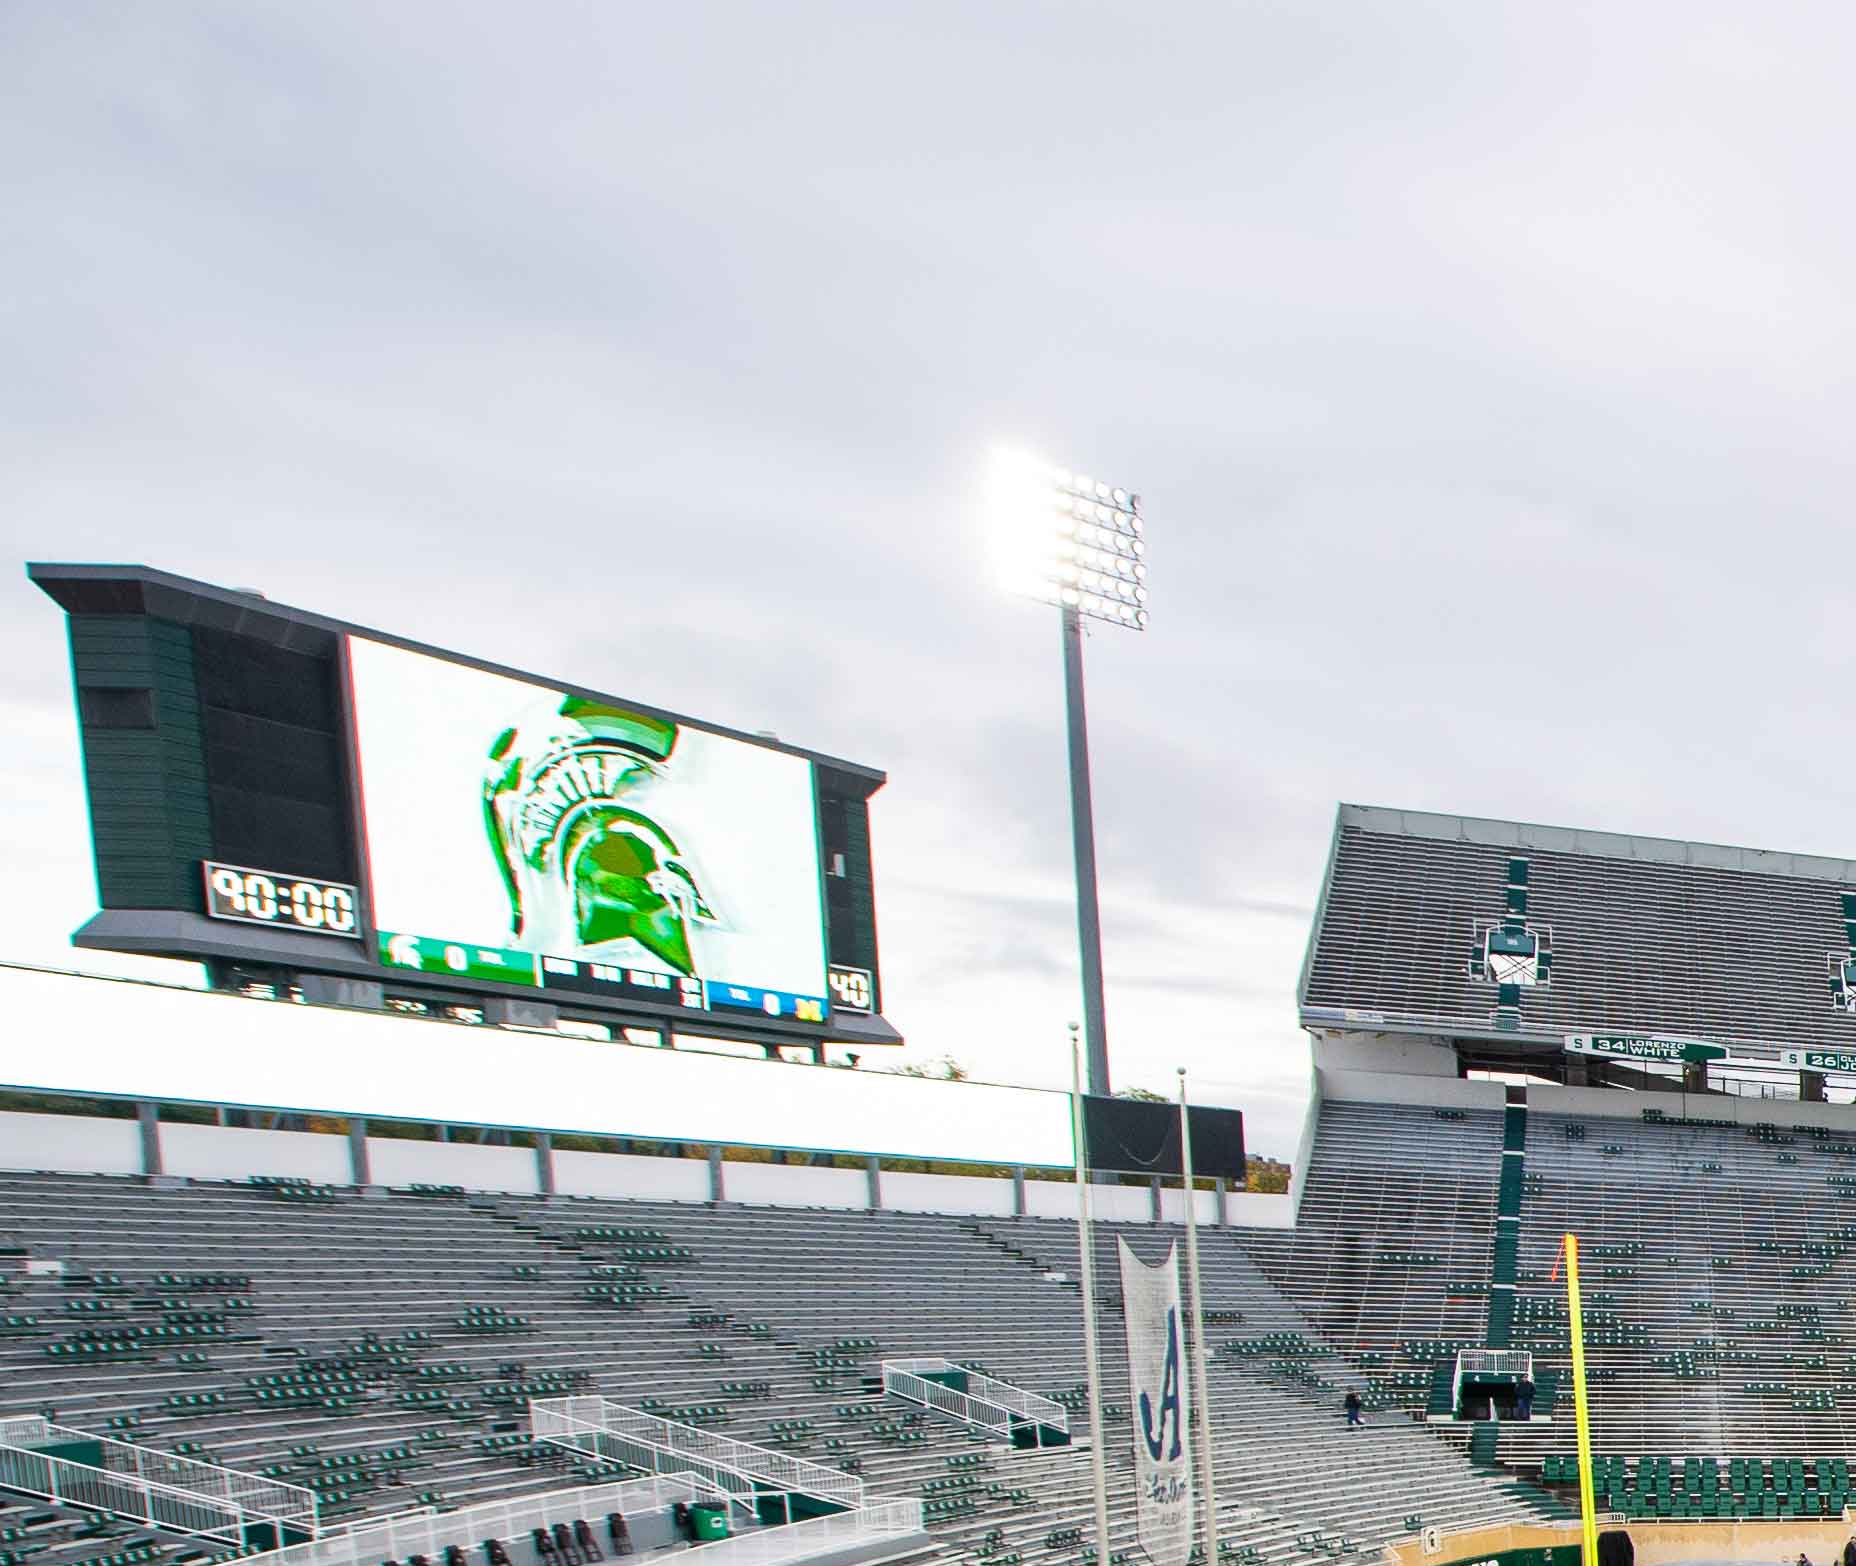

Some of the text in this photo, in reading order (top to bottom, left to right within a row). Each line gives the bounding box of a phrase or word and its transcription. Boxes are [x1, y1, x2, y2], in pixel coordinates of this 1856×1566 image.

[211, 868, 355, 932] 90:00
[829, 973, 869, 1008] 40
[1598, 1039, 1625, 1052] 34
[1628, 1039, 1686, 1051] LORENZO
[1629, 1046, 1681, 1058] WHITE
[1811, 1054, 1837, 1067] 26
